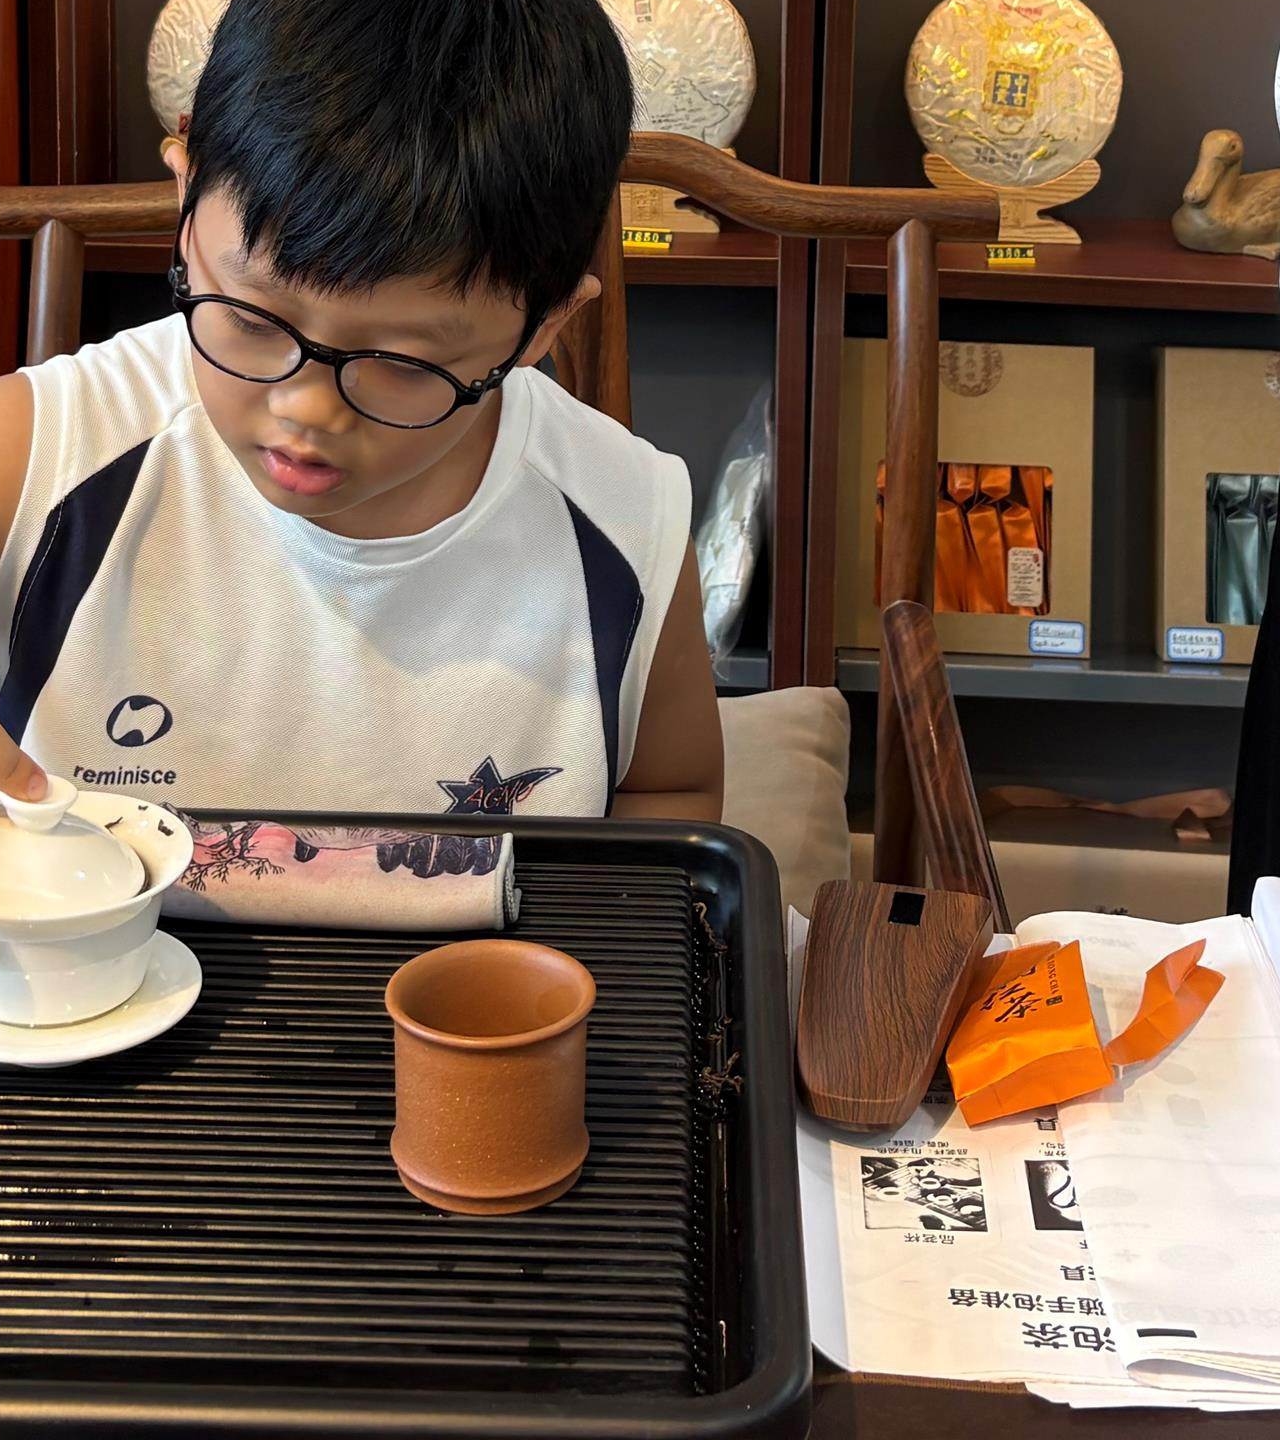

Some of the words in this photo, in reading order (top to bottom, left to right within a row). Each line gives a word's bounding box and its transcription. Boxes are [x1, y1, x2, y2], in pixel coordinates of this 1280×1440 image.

[73, 765, 177, 785] reminisce
[903, 1233, 956, 1245] 品茗杯
[948, 1288, 1107, 1316] 随手泡准备
[1022, 1321, 1117, 1352] 泡茶
